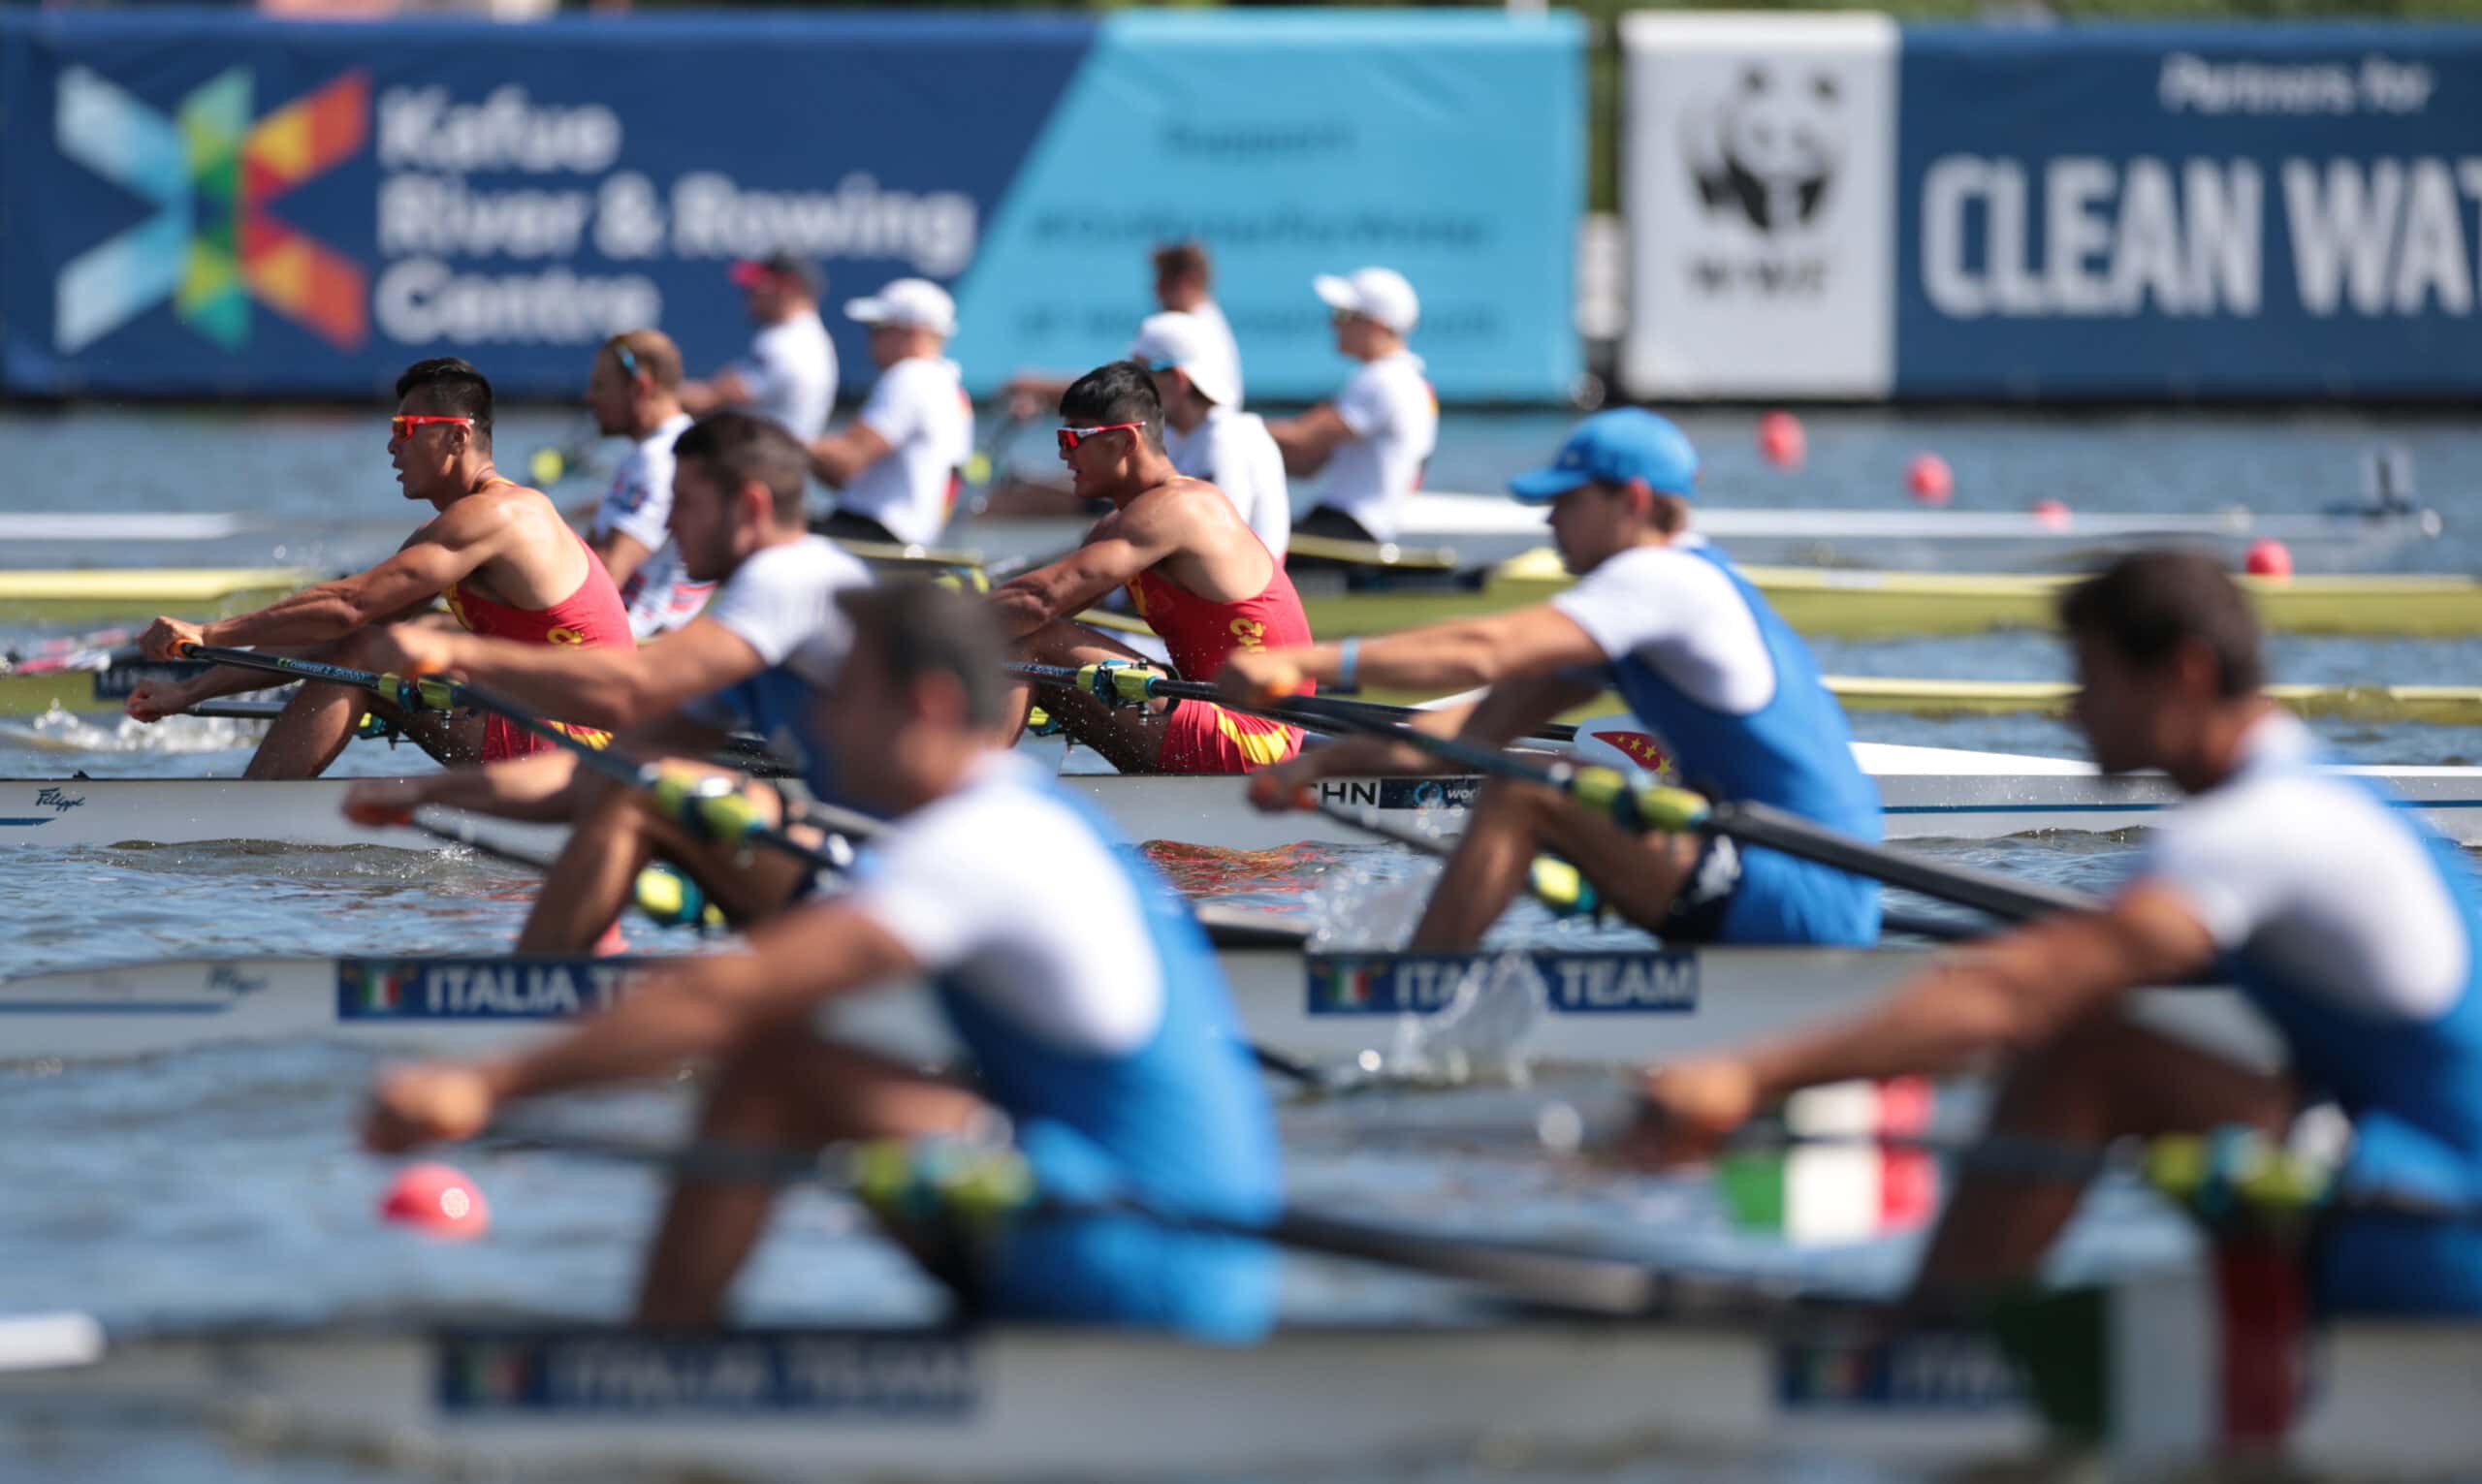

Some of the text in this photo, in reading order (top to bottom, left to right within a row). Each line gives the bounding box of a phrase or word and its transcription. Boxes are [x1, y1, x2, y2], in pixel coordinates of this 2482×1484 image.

[2158, 52, 2432, 114] Partners for
[377, 85, 623, 174] Kafue
[377, 174, 589, 257] River
[594, 172, 668, 260] &
[671, 172, 976, 275] Rowing
[1921, 155, 2264, 317] CLEAN
[375, 258, 663, 343] Centre
[427, 966, 580, 1013] ITALIA
[1556, 960, 1694, 1007] TEAM
